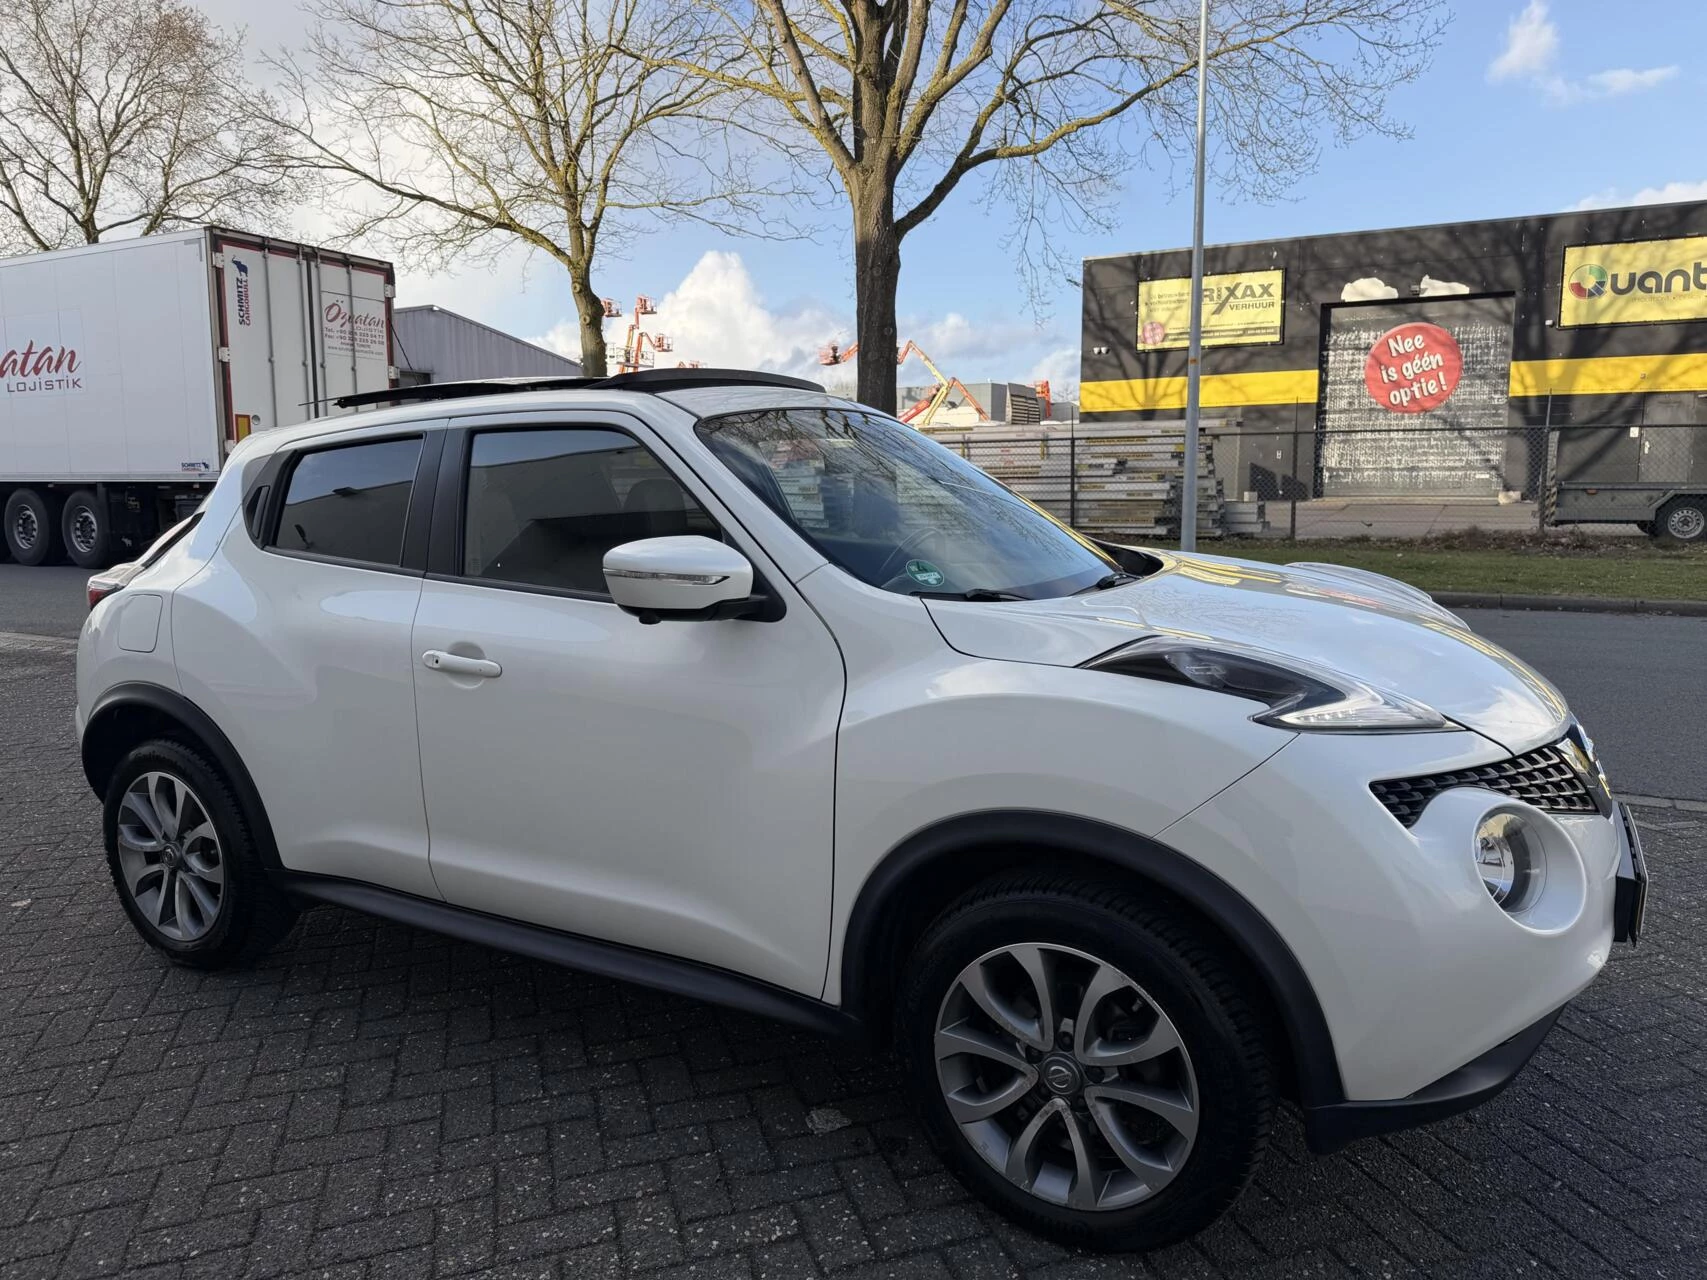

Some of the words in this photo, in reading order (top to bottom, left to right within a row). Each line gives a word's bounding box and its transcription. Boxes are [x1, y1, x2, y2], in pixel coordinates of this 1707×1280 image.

[236, 277, 246, 325] SCHMITZ
[1229, 301, 1275, 311] VERHUUR
[1388, 335, 1425, 357] Nee
[1381, 365, 1398, 384] is
[1402, 351, 1444, 380] géén
[1390, 371, 1448, 407] optie!
